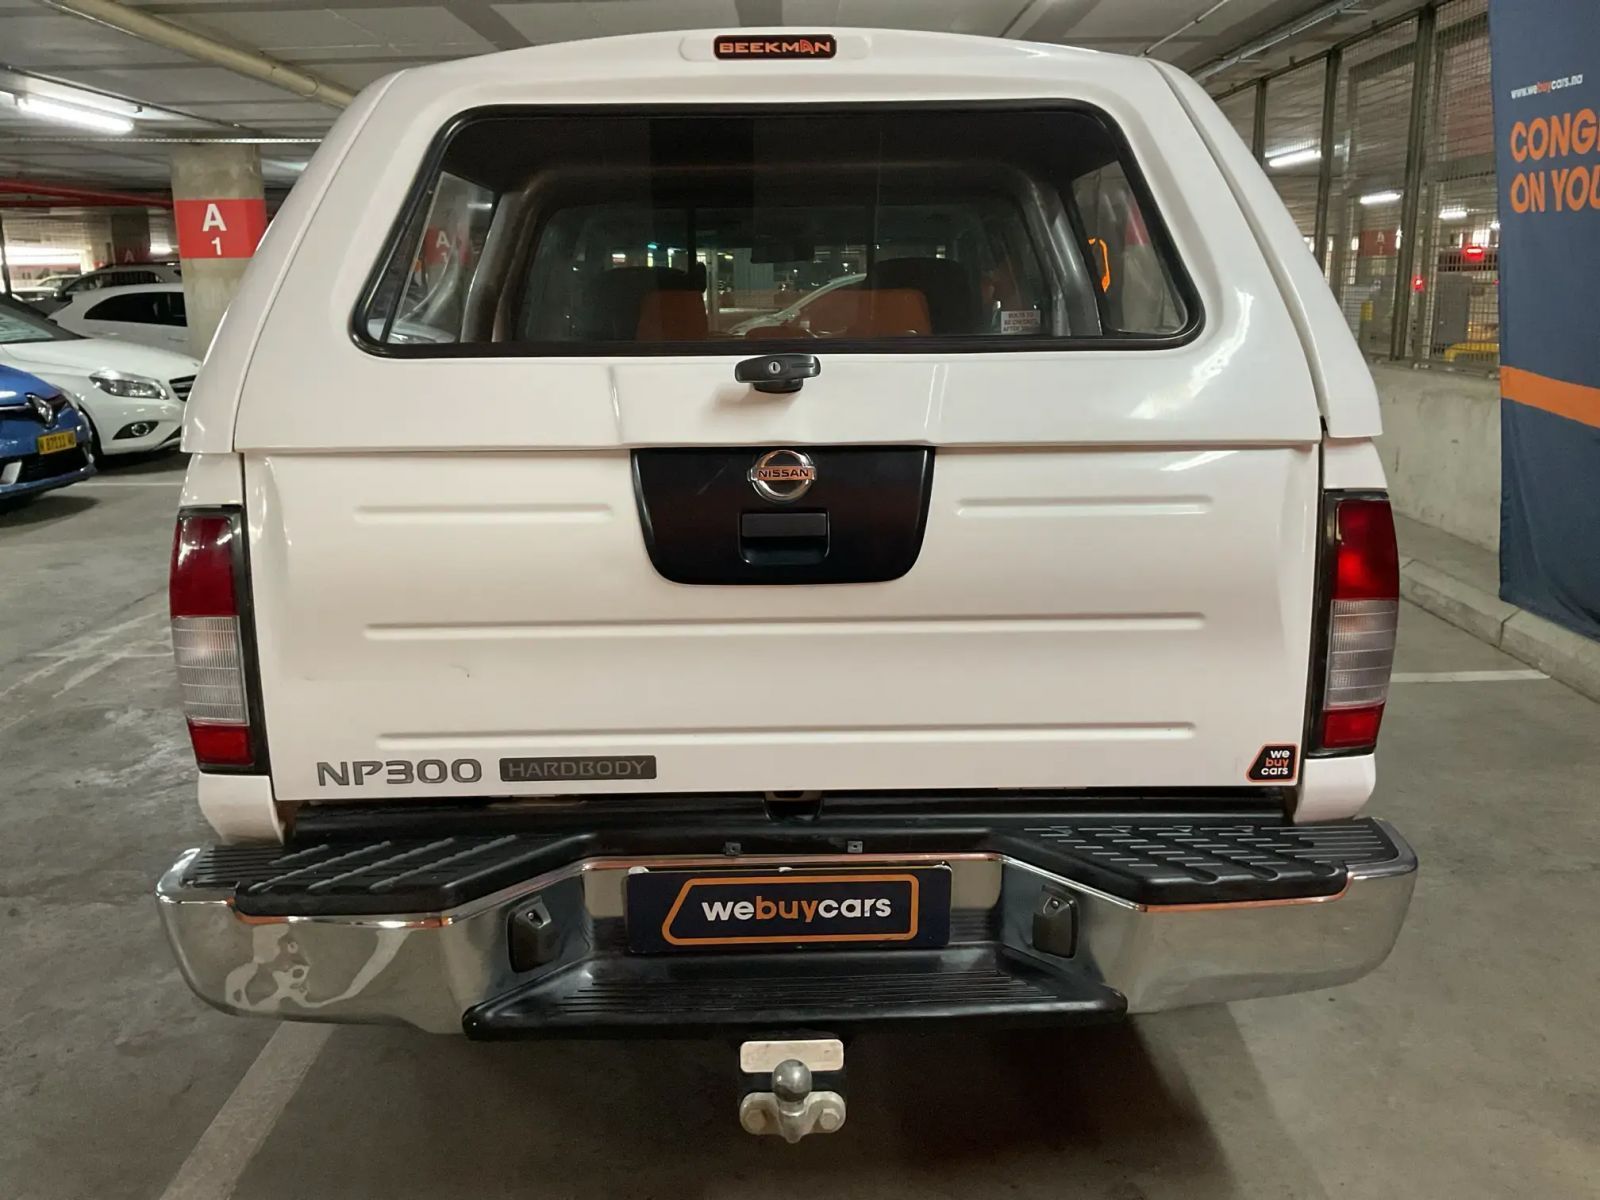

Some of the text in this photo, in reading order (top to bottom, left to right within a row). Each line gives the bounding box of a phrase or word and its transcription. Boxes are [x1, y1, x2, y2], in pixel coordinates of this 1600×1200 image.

[719, 39, 831, 54] BEEKMAN
[1510, 108, 1600, 162] CONG
[1510, 171, 1545, 213] ON
[202, 203, 227, 232] A
[211, 236, 222, 256] 1
[758, 469, 809, 478] NISSAN
[1265, 757, 1289, 768] buy
[1270, 750, 1290, 758] we
[316, 758, 648, 786] NP300 HARDBODY
[1261, 767, 1288, 775] cars
[701, 895, 892, 922] webuycars
